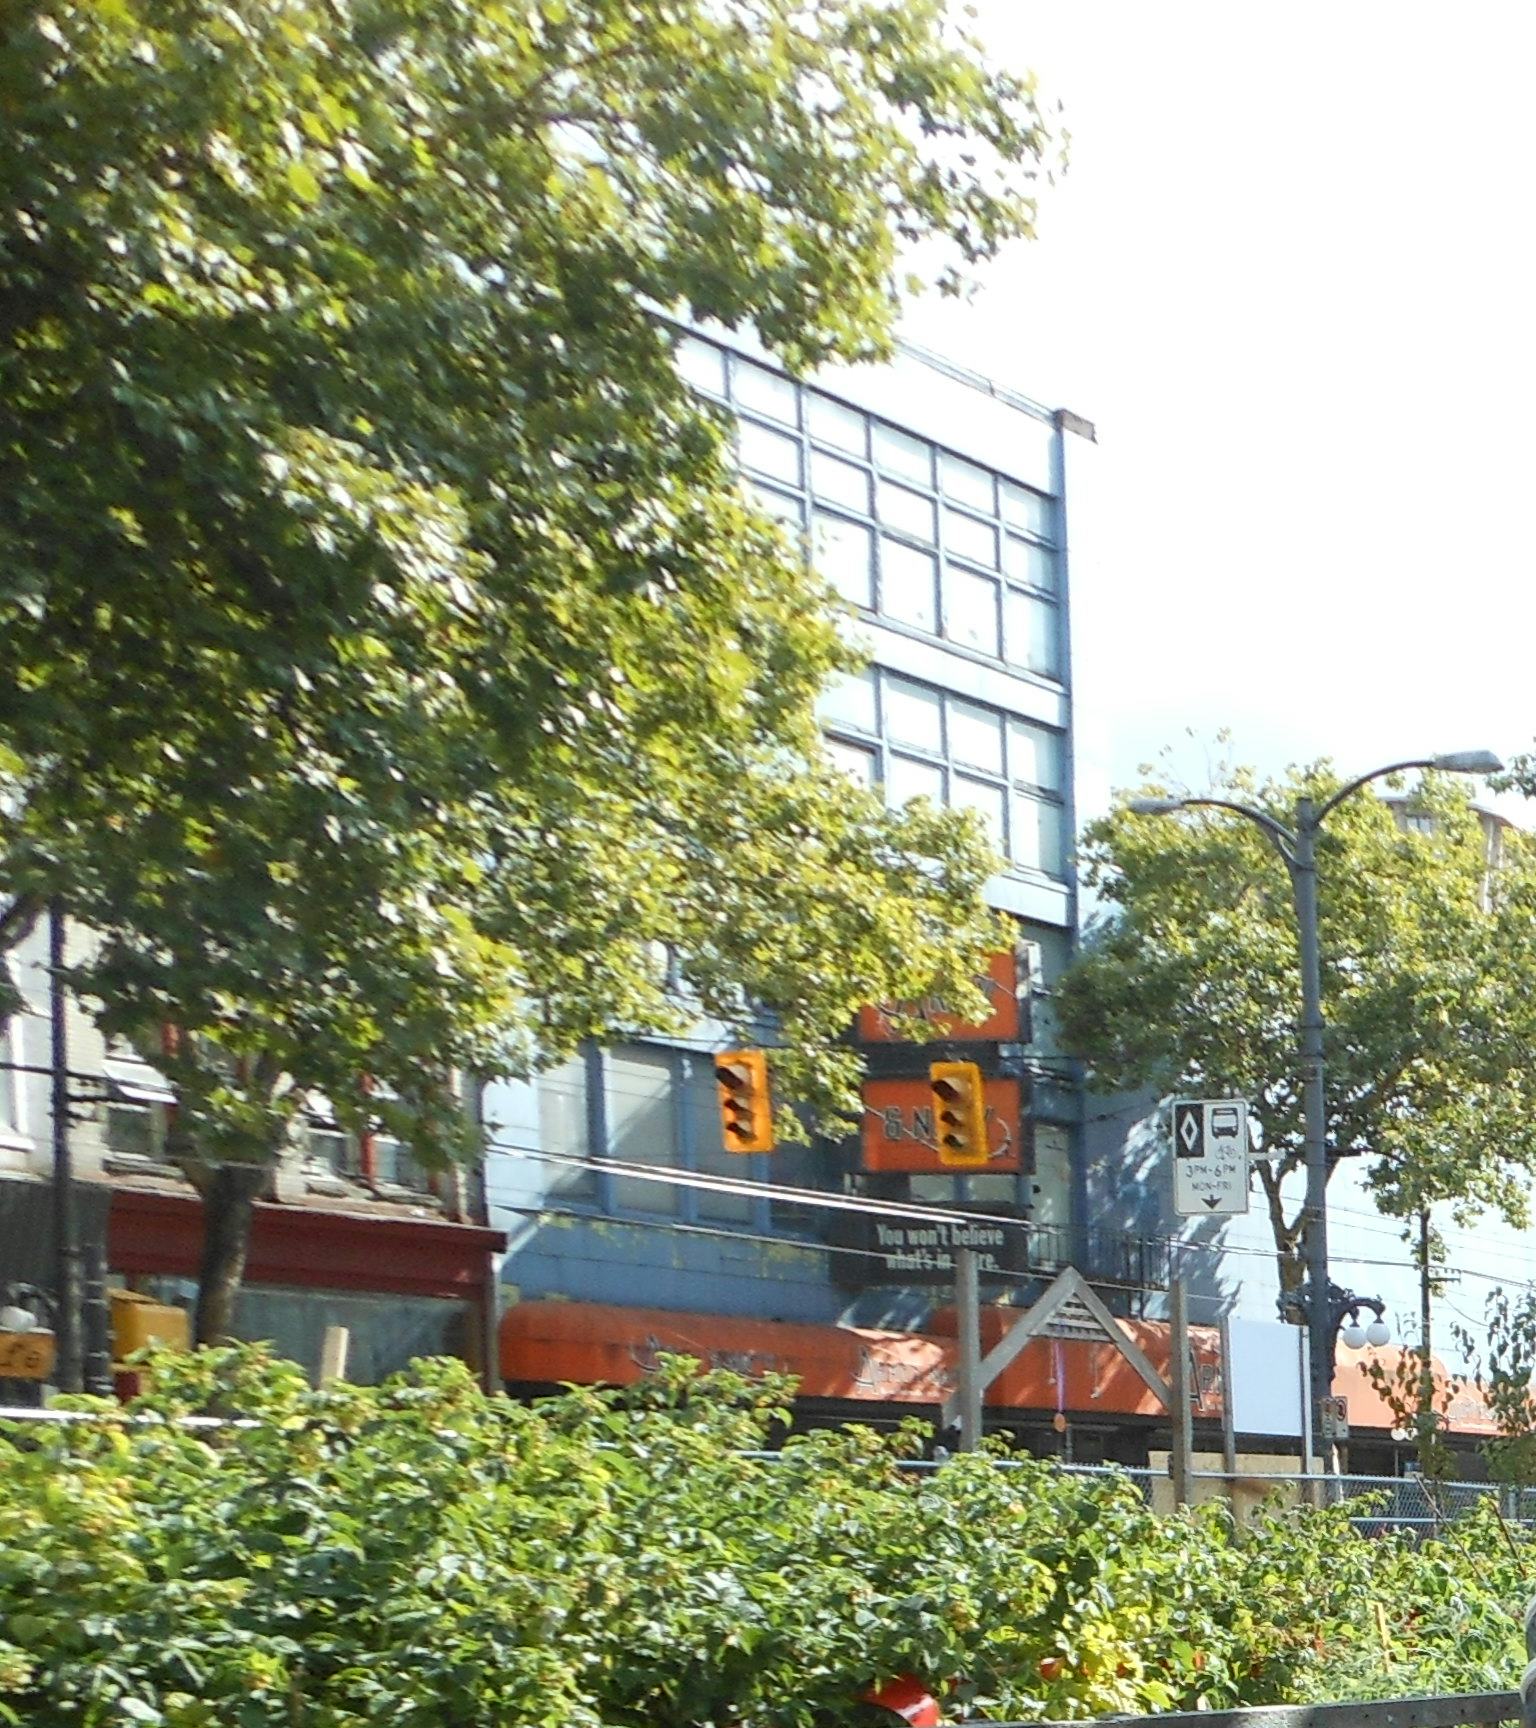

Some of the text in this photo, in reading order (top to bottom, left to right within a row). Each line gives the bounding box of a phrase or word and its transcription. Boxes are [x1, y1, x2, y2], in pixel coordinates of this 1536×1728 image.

[876, 1222, 1004, 1246] You won't believe
[886, 1248, 933, 1269] what's
